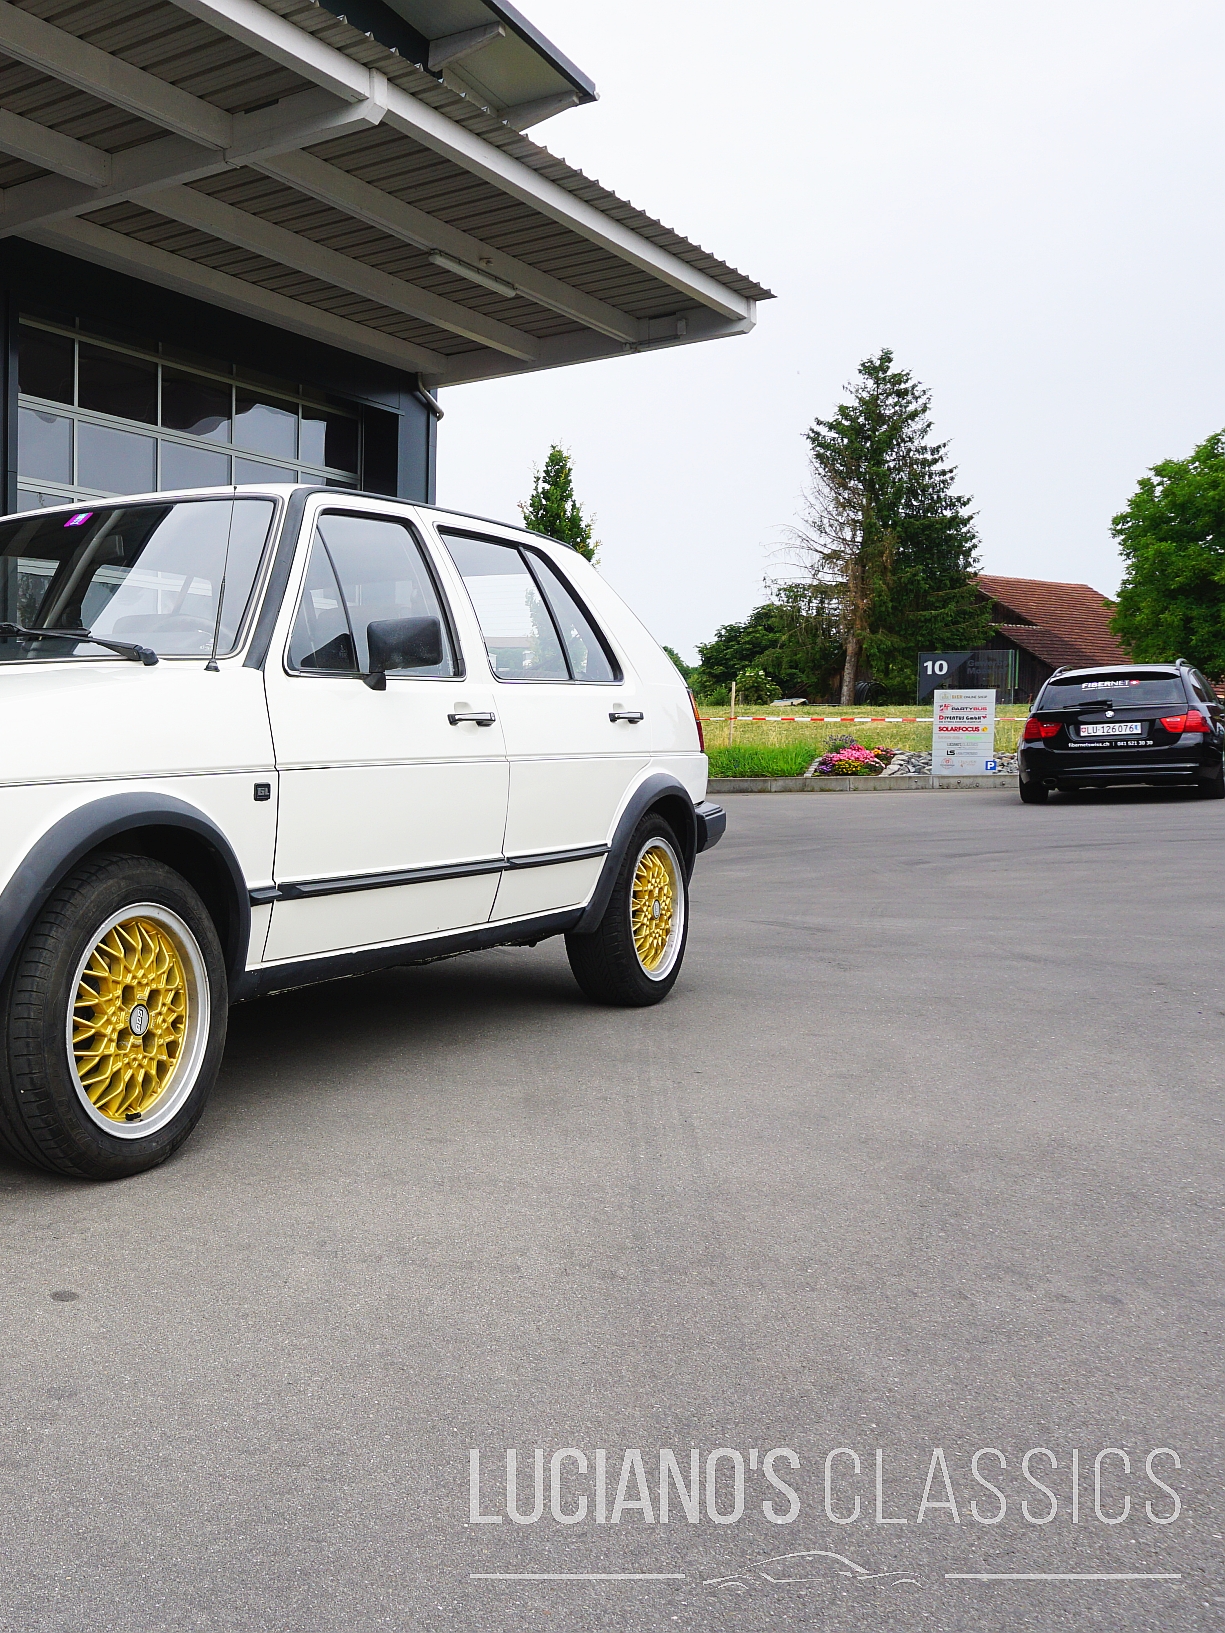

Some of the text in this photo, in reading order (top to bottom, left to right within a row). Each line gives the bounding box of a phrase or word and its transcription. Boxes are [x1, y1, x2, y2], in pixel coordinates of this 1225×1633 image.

[923, 660, 949, 675] 10
[1081, 680, 1130, 689] FIBERNET
[987, 761, 995, 770] P
